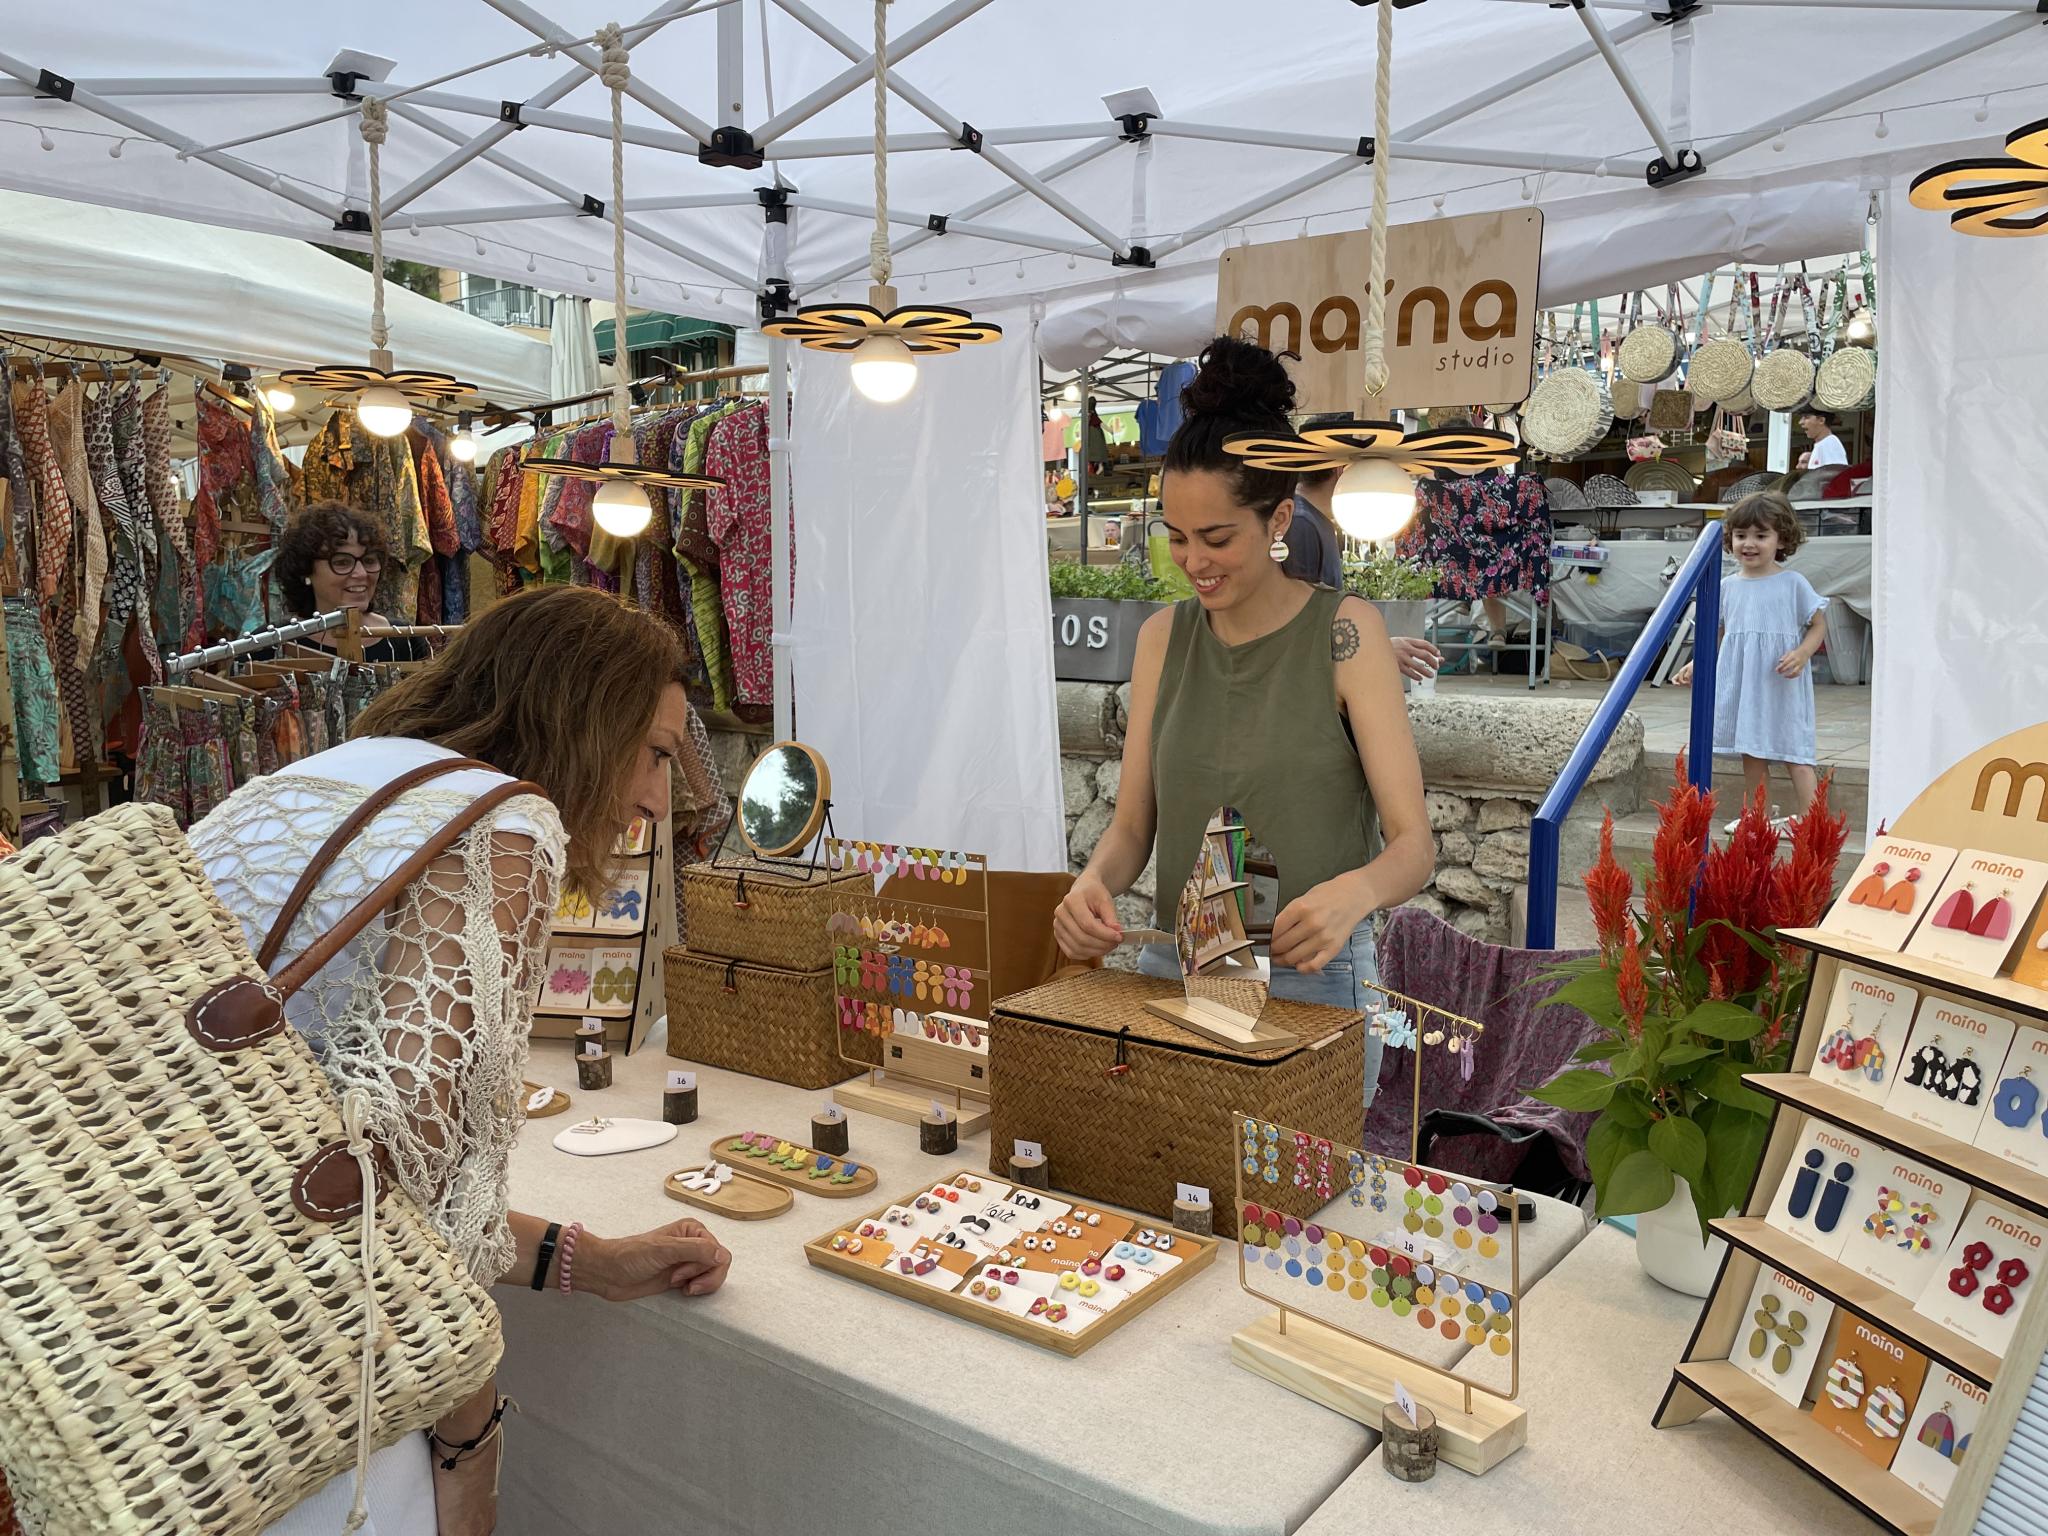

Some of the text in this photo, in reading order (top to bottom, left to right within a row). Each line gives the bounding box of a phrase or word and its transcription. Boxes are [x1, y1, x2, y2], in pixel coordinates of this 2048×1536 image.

[1435, 347, 1514, 371] studio
[1052, 611, 1109, 649] OS
[676, 1077, 686, 1085] 16
[1024, 1148, 1033, 1157] 12
[1188, 1193, 1199, 1203] 14
[1404, 1241, 1414, 1253] 18
[1402, 1397, 1410, 1413] 16
